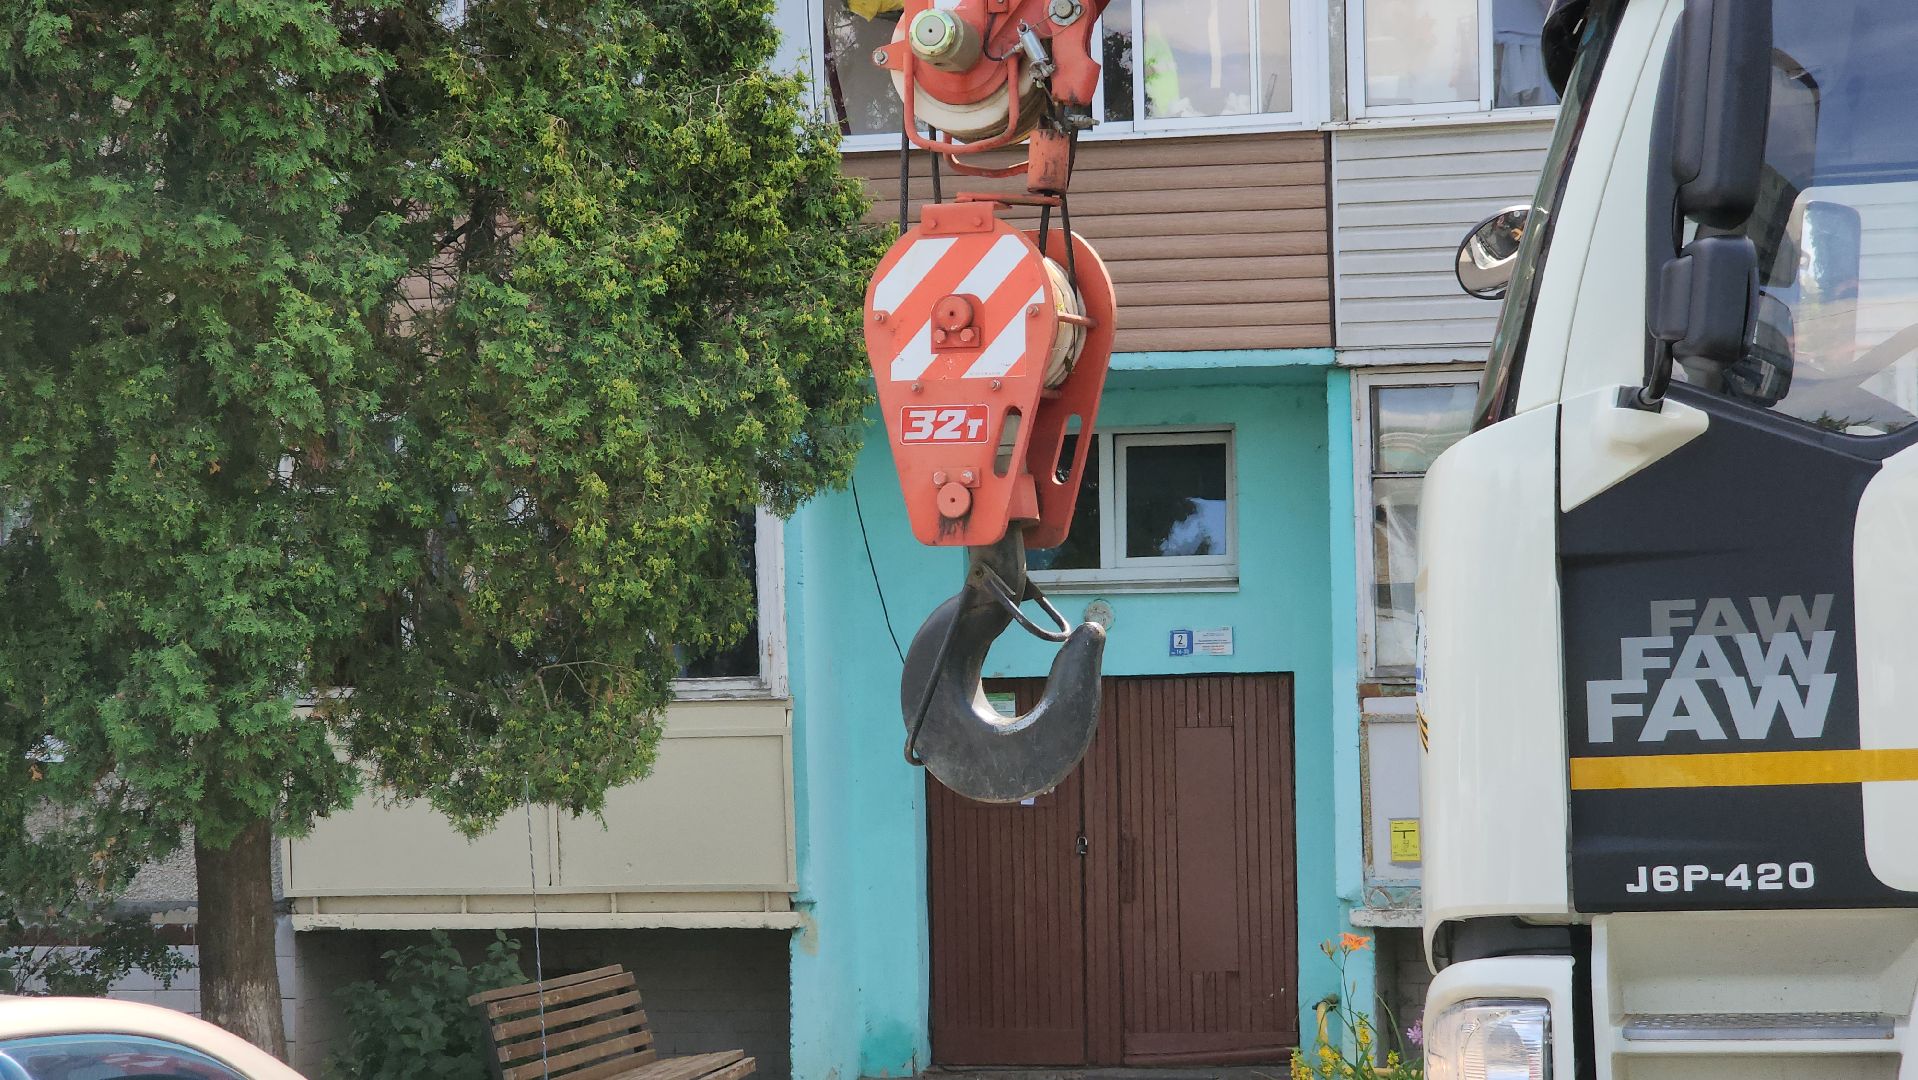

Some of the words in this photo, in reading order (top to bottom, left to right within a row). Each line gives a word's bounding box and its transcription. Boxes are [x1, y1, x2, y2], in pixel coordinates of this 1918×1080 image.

[1178, 634, 1183, 645] 2
[1650, 593, 1834, 643] FAW
[1620, 630, 1836, 687] FAW
[1586, 672, 1837, 743] FAW
[1626, 861, 1815, 893] J6P-420
